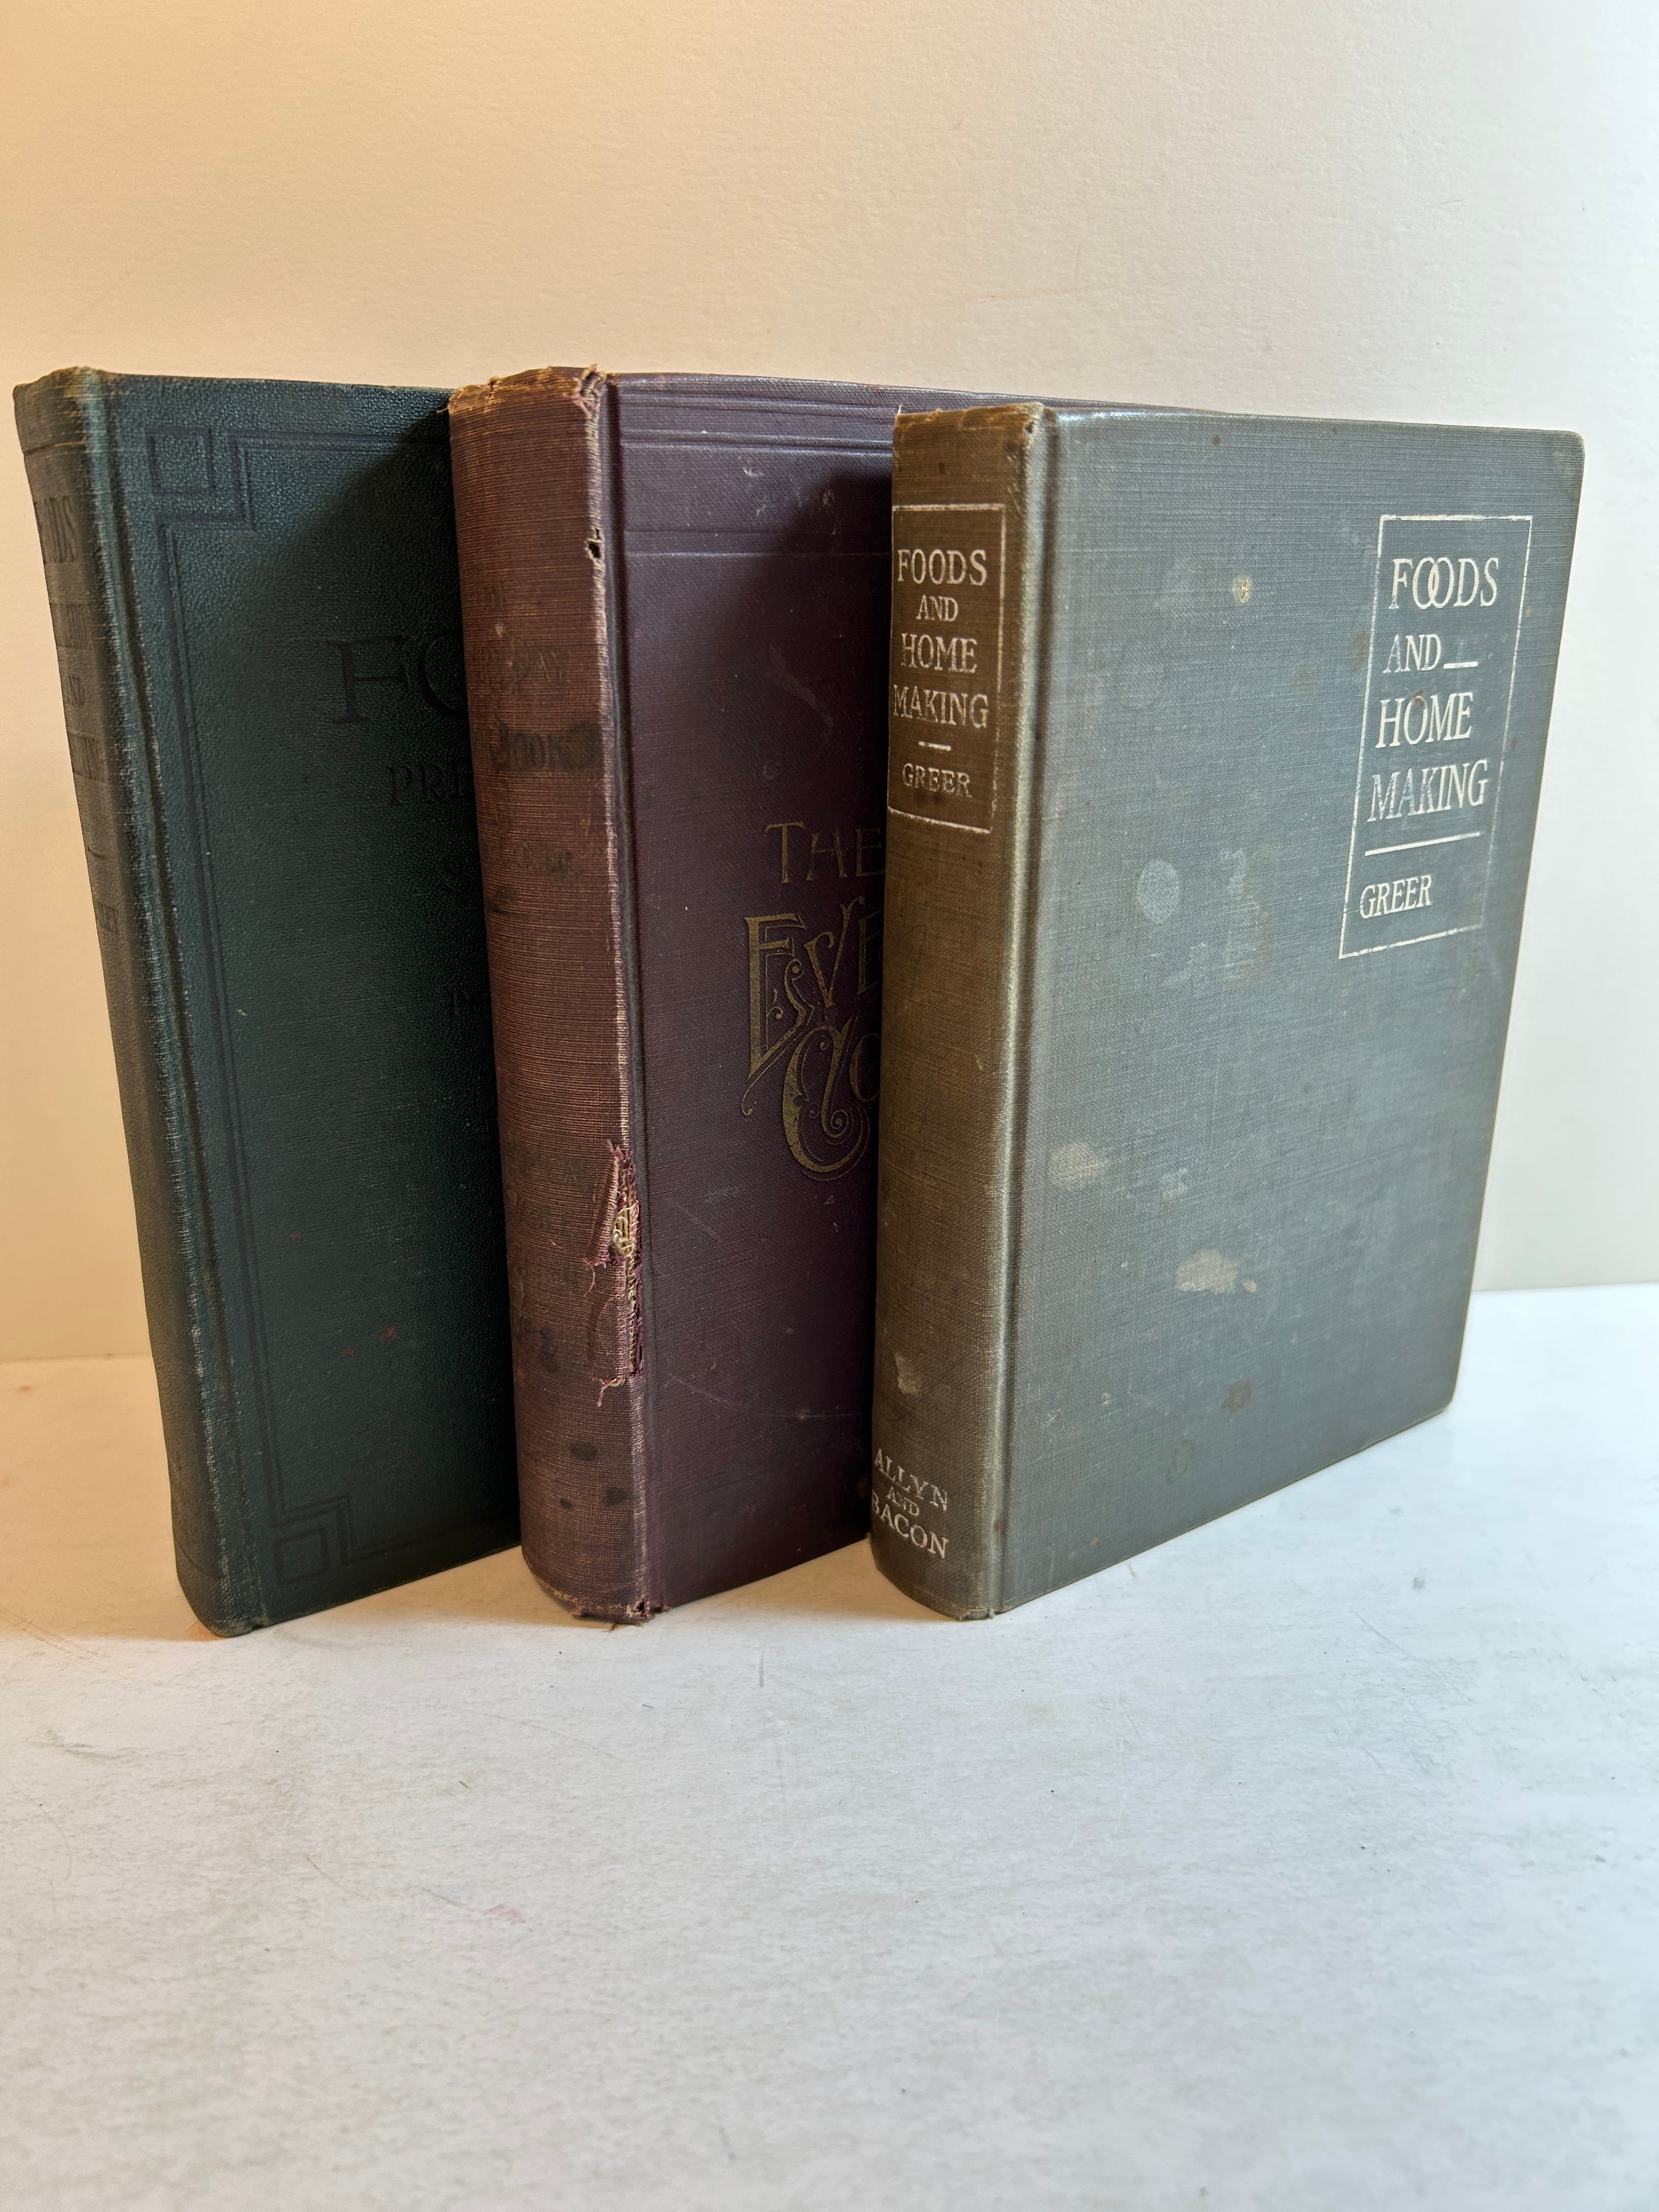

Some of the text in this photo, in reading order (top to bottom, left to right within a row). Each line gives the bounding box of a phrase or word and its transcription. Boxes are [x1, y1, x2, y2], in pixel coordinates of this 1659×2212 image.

[897, 548, 989, 586] FOODS
[1387, 556, 1500, 611] FOODS
[916, 594, 960, 622] AND
[900, 633, 978, 674] HOME
[1382, 634, 1443, 674] AND
[893, 684, 990, 729] MAKING
[1375, 691, 1475, 749] HOME
[902, 763, 973, 799] GREER
[1366, 758, 1489, 823] MAKING
[764, 821, 884, 884] THE
[1358, 874, 1434, 920] GREER
[874, 1448, 948, 1511] ALLYN
[885, 1486, 921, 1517] AND
[871, 1491, 950, 1559] BACON
